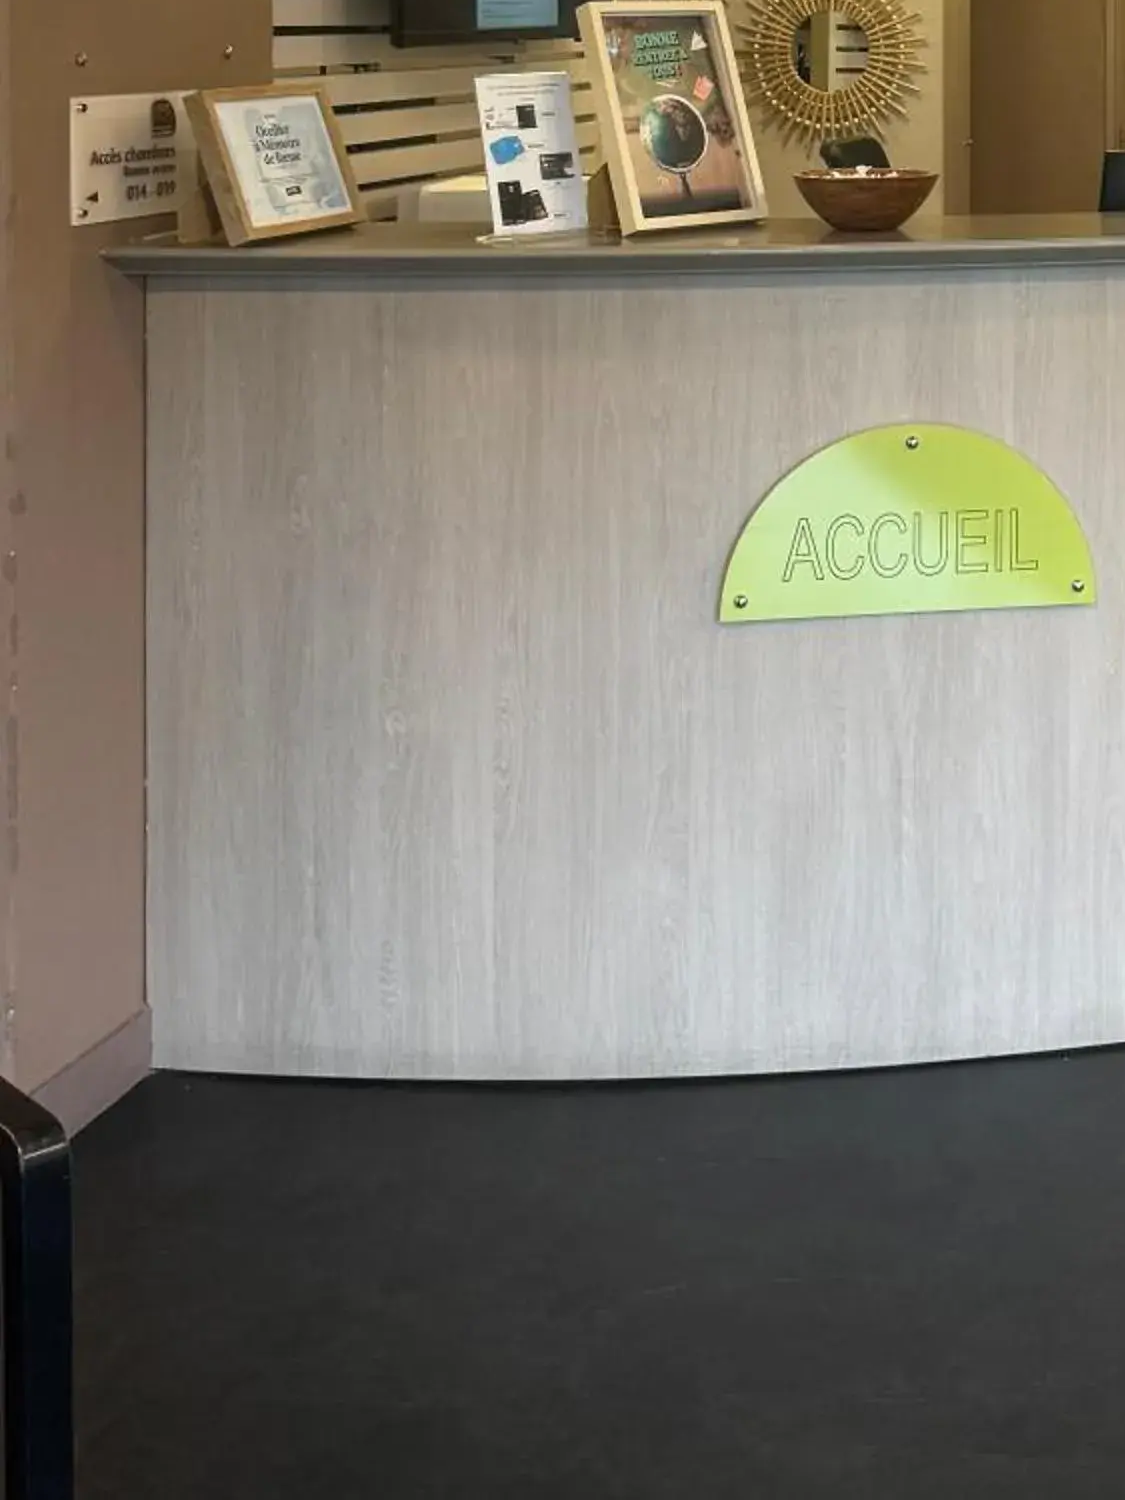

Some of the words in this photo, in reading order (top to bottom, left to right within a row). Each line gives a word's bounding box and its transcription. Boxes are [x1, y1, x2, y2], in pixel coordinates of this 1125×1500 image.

[90, 148, 122, 166] Accès
[125, 144, 176, 163] chambres
[126, 184, 147, 201] 014
[782, 507, 1039, 582] ACCUEIL
